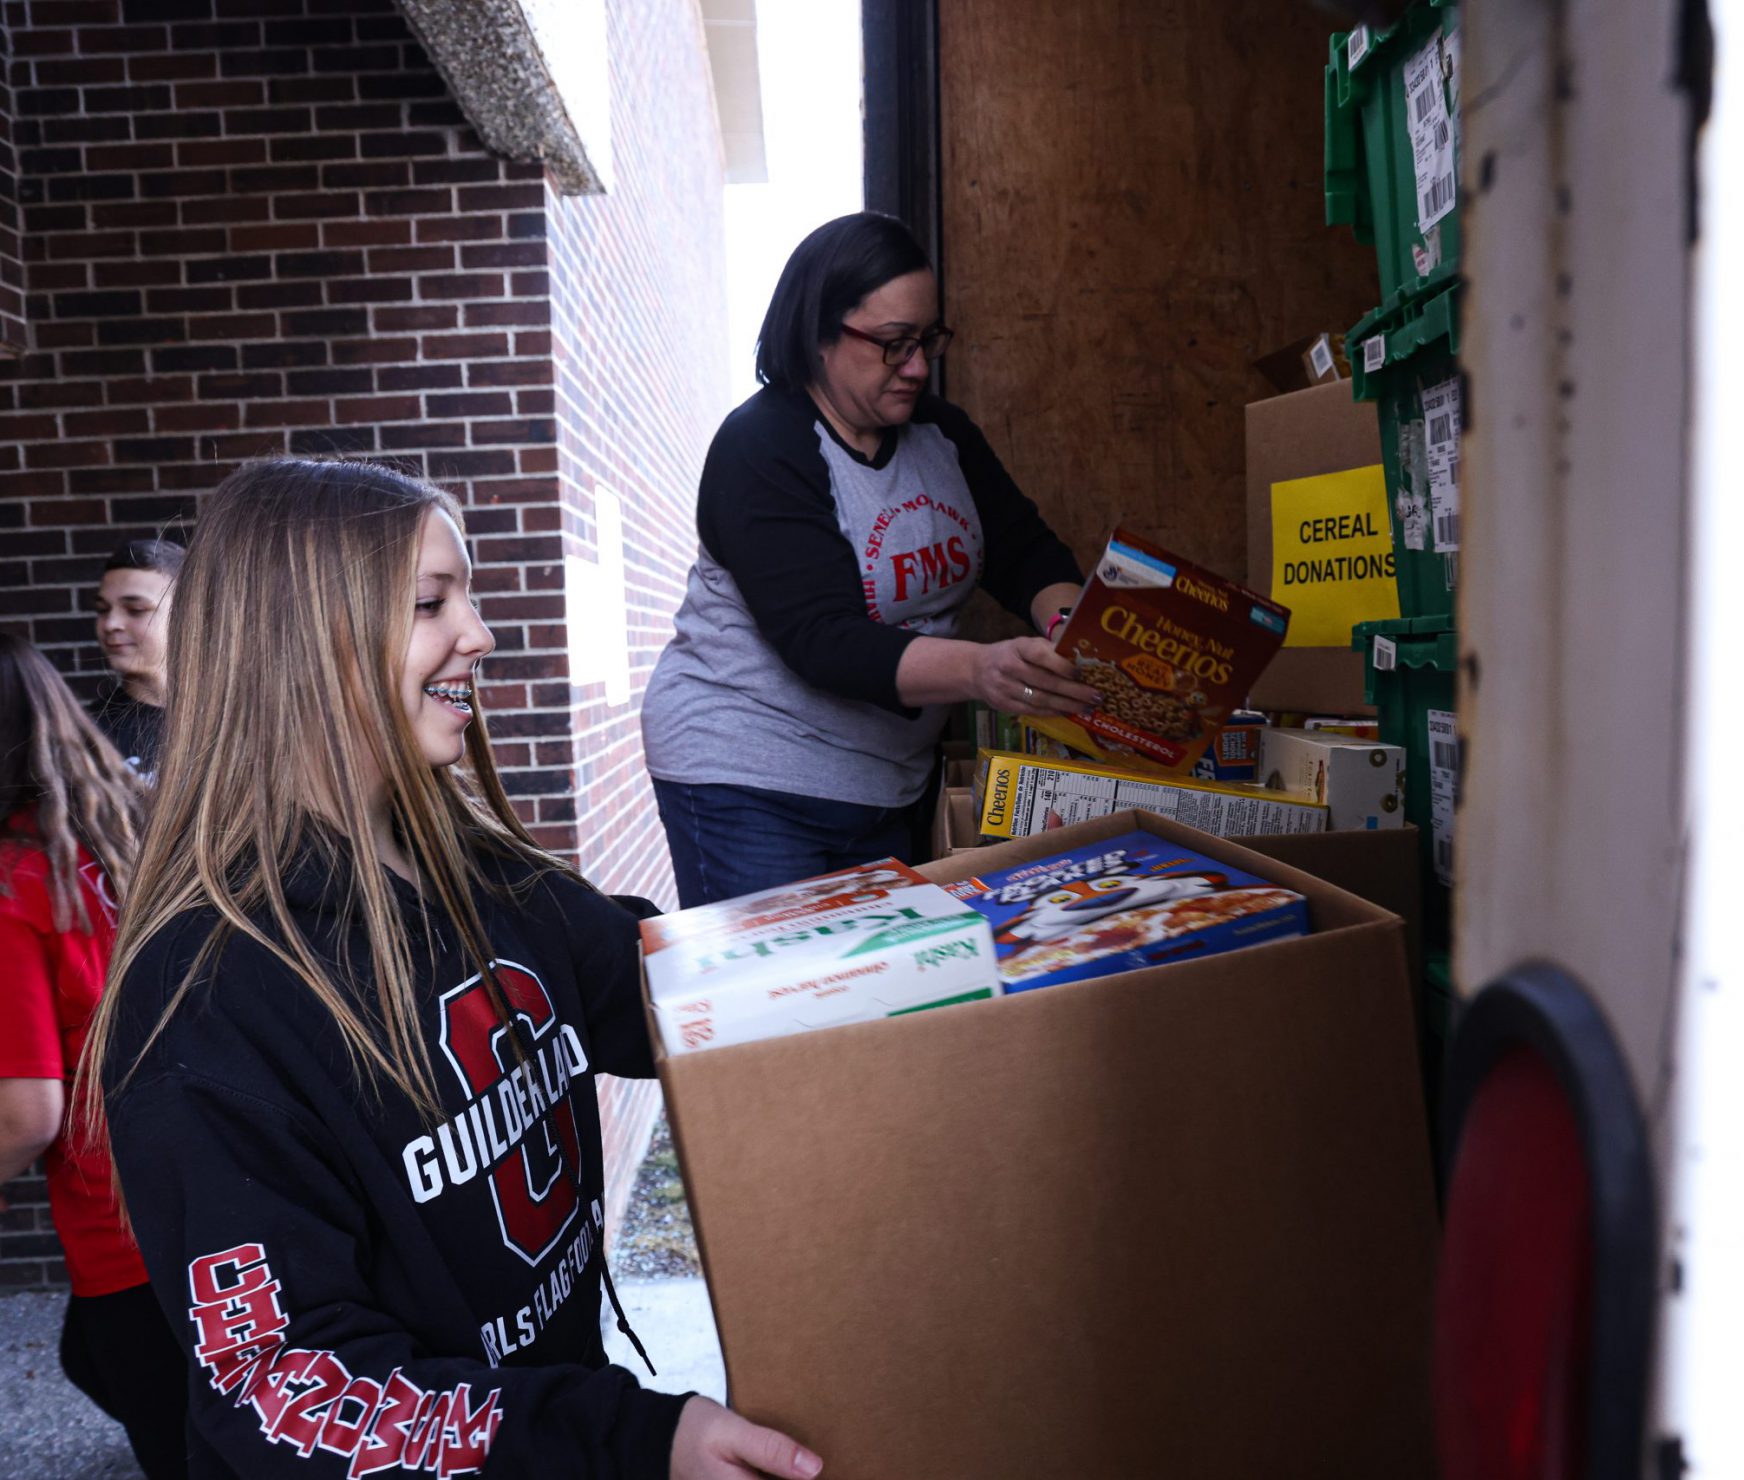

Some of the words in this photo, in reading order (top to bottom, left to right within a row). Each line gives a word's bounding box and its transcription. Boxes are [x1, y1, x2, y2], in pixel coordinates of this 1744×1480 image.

[1300, 512, 1378, 544] CEREAL
[890, 536, 971, 602] FMS
[1284, 553, 1396, 585] DONATIONS
[1175, 576, 1230, 612] Cheerios
[1101, 605, 1233, 685] Cheerios
[1156, 616, 1201, 649] Honey
[1206, 638, 1234, 661] Nut
[1093, 719, 1175, 758] CHOLESTEROL
[1044, 790, 1052, 801] 140
[1047, 770, 1055, 781] 210
[987, 769, 1010, 826] Cheerios
[695, 907, 924, 974] Kashi
[913, 937, 980, 972] Kashi
[402, 1023, 589, 1204] GUILDERLAD
[480, 1305, 536, 1369] RLS
[533, 1258, 571, 1332] FLAG
